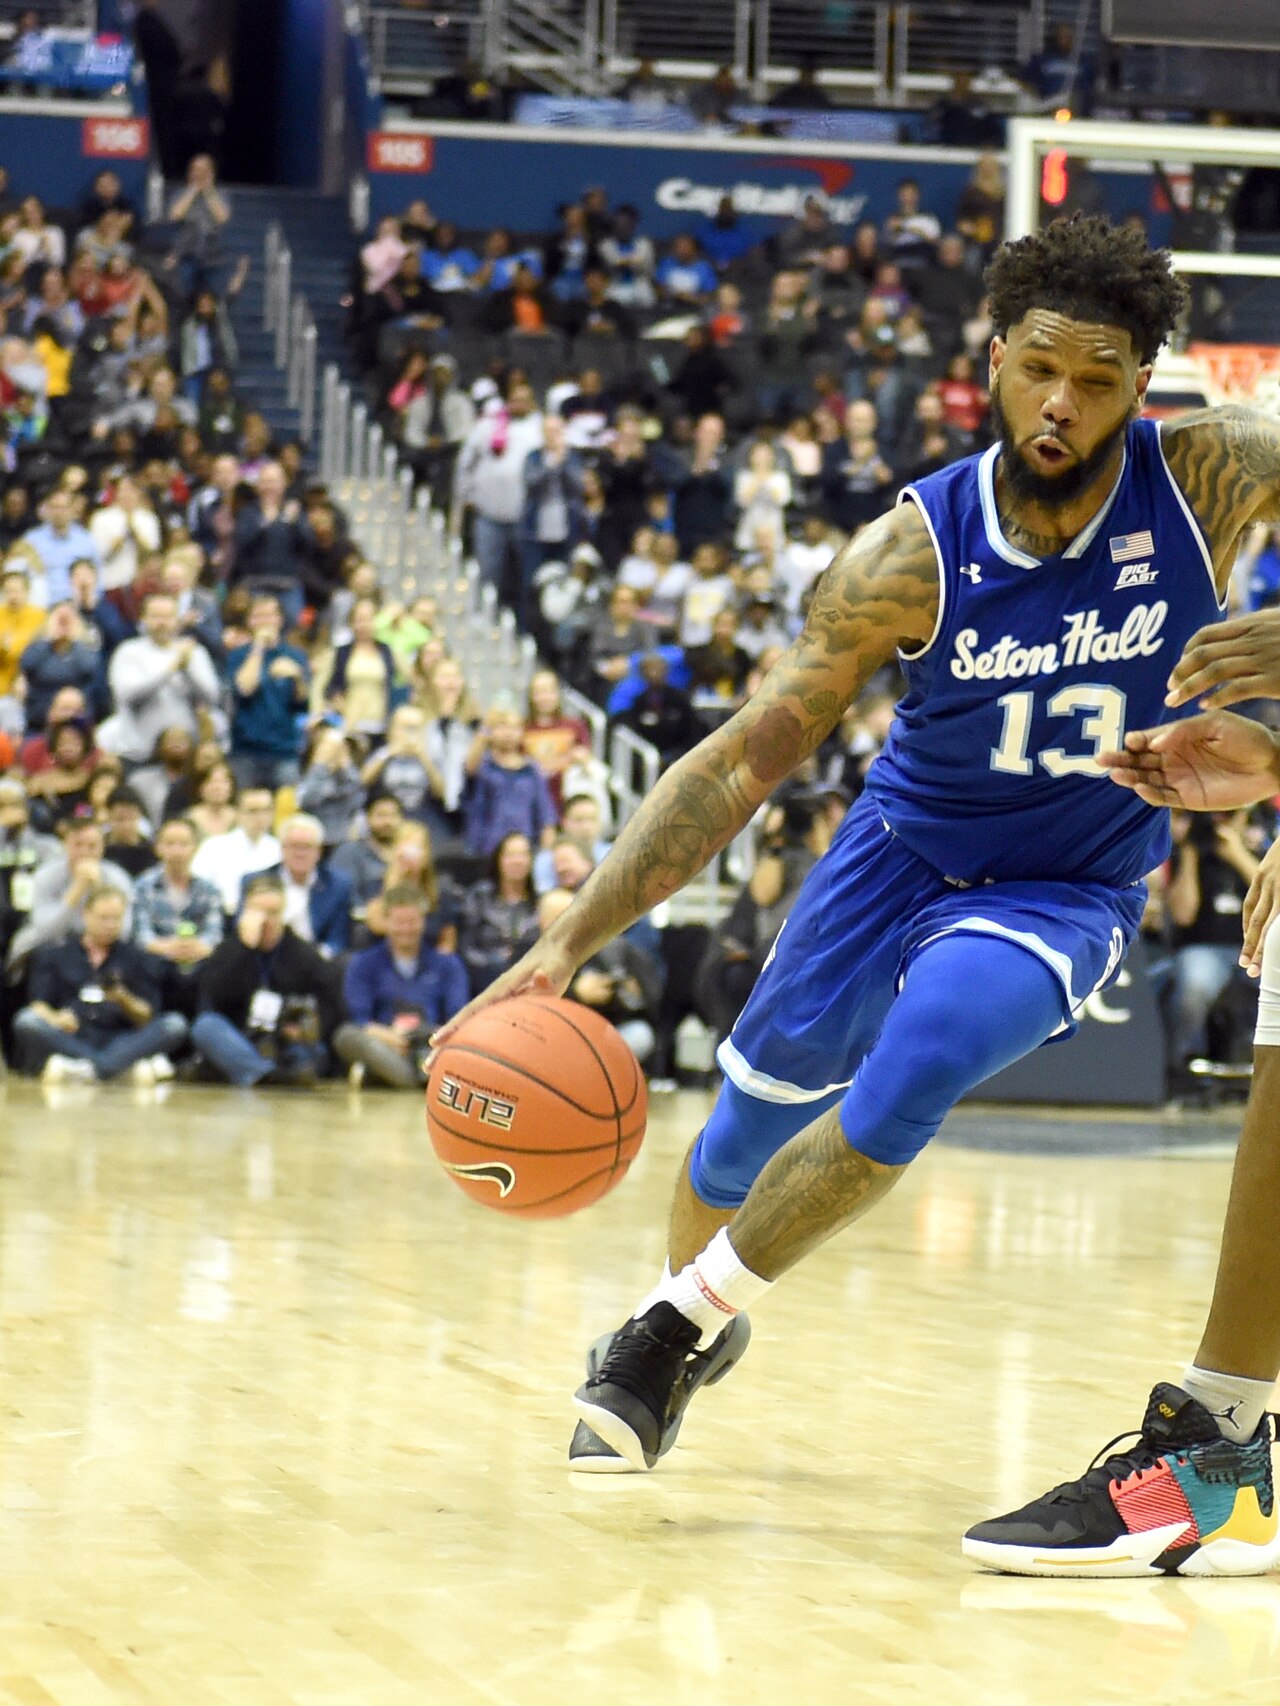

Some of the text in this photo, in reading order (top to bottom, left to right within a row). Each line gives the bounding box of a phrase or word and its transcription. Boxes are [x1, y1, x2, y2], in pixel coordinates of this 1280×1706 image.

[1116, 570, 1160, 586] EAST
[1121, 562, 1151, 576] BIG
[951, 600, 1169, 681] Seton Hall
[989, 682, 1128, 779] 13
[437, 1076, 516, 1132] ELITE
